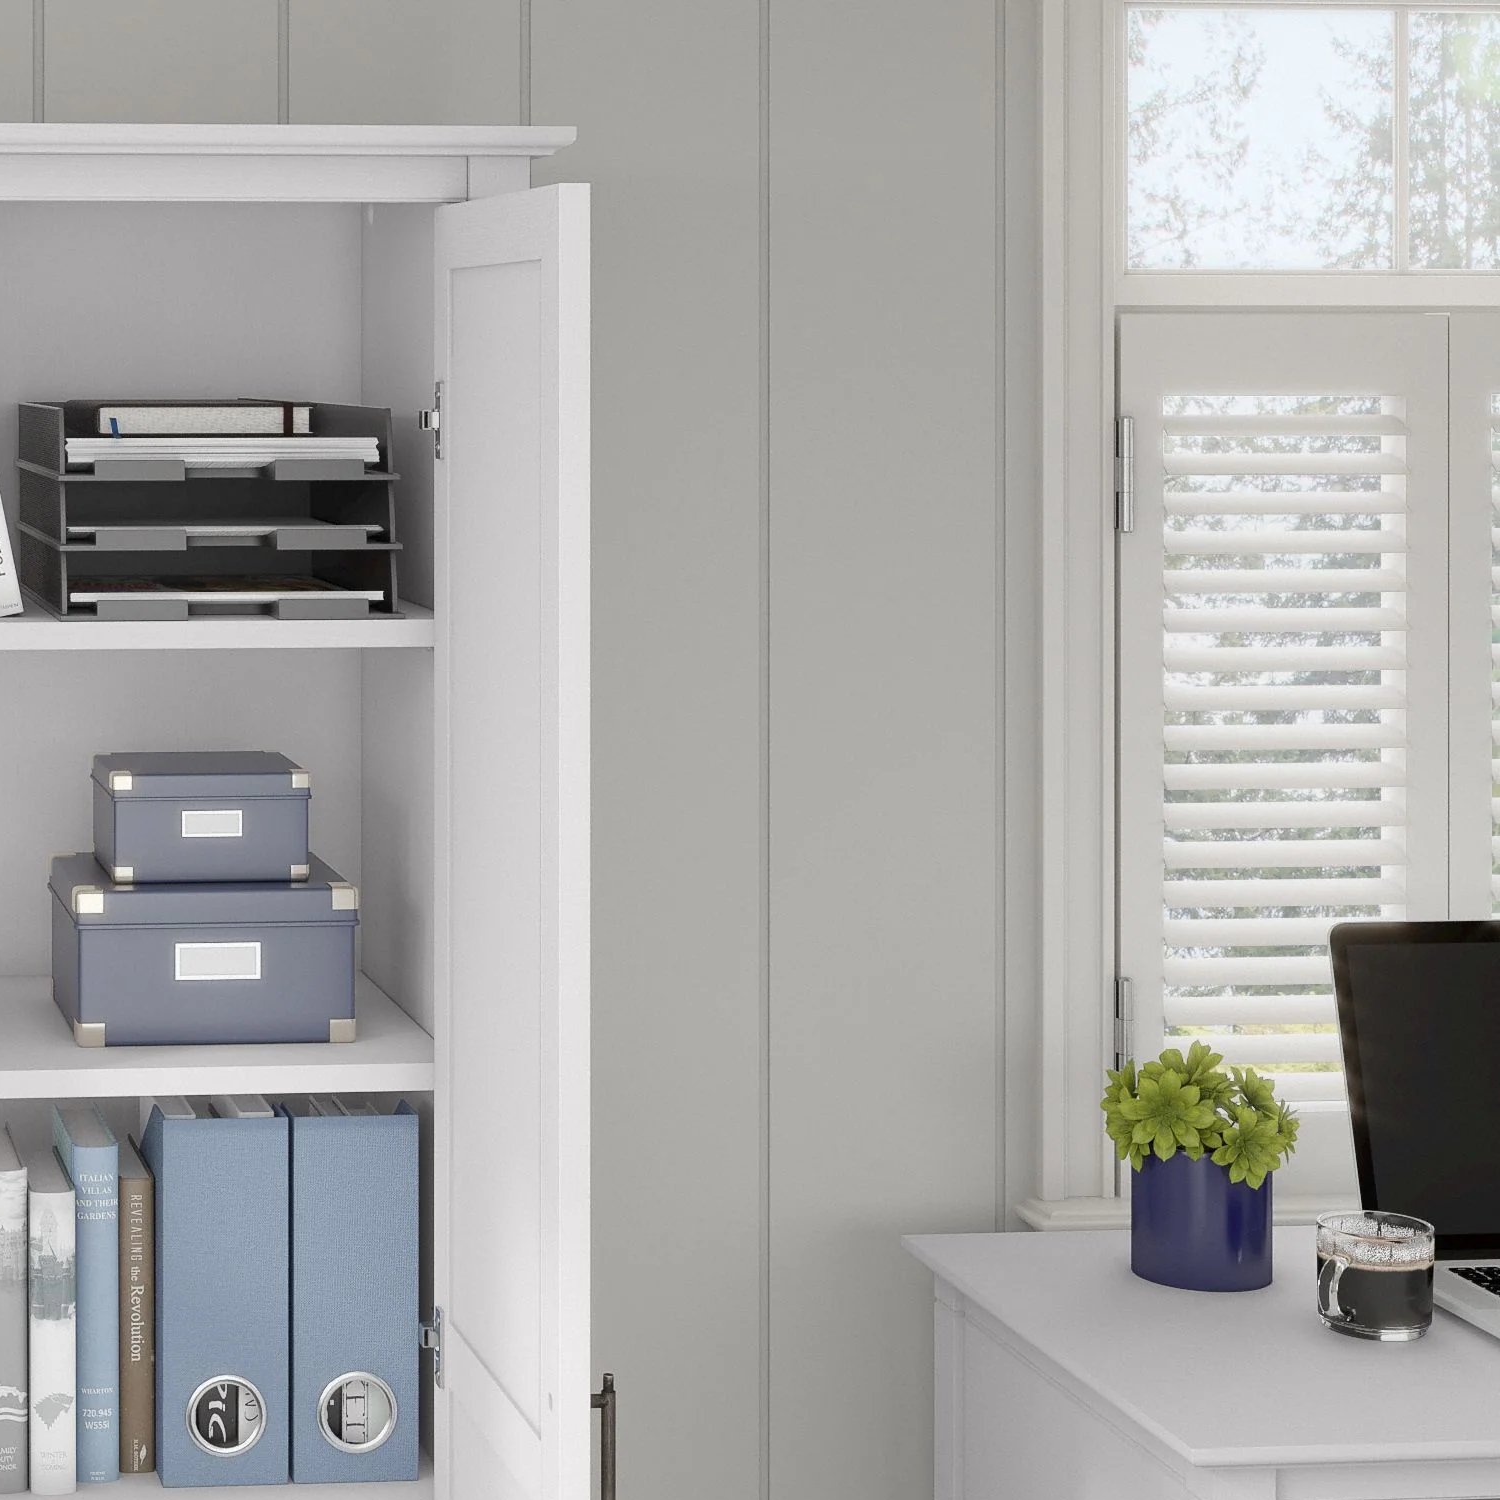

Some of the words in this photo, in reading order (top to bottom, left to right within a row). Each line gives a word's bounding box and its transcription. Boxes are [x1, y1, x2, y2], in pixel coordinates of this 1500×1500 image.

[79, 1173, 114, 1182] ITALIAN
[81, 1186, 111, 1195] VILLAS
[77, 1211, 116, 1220] GARDENS
[130, 1194, 143, 1261] REVEALING
[130, 1266, 140, 1282] the
[130, 1285, 144, 1362] Revolution
[81, 1387, 113, 1395] WHARTON
[82, 1408, 112, 1418] 720.945
